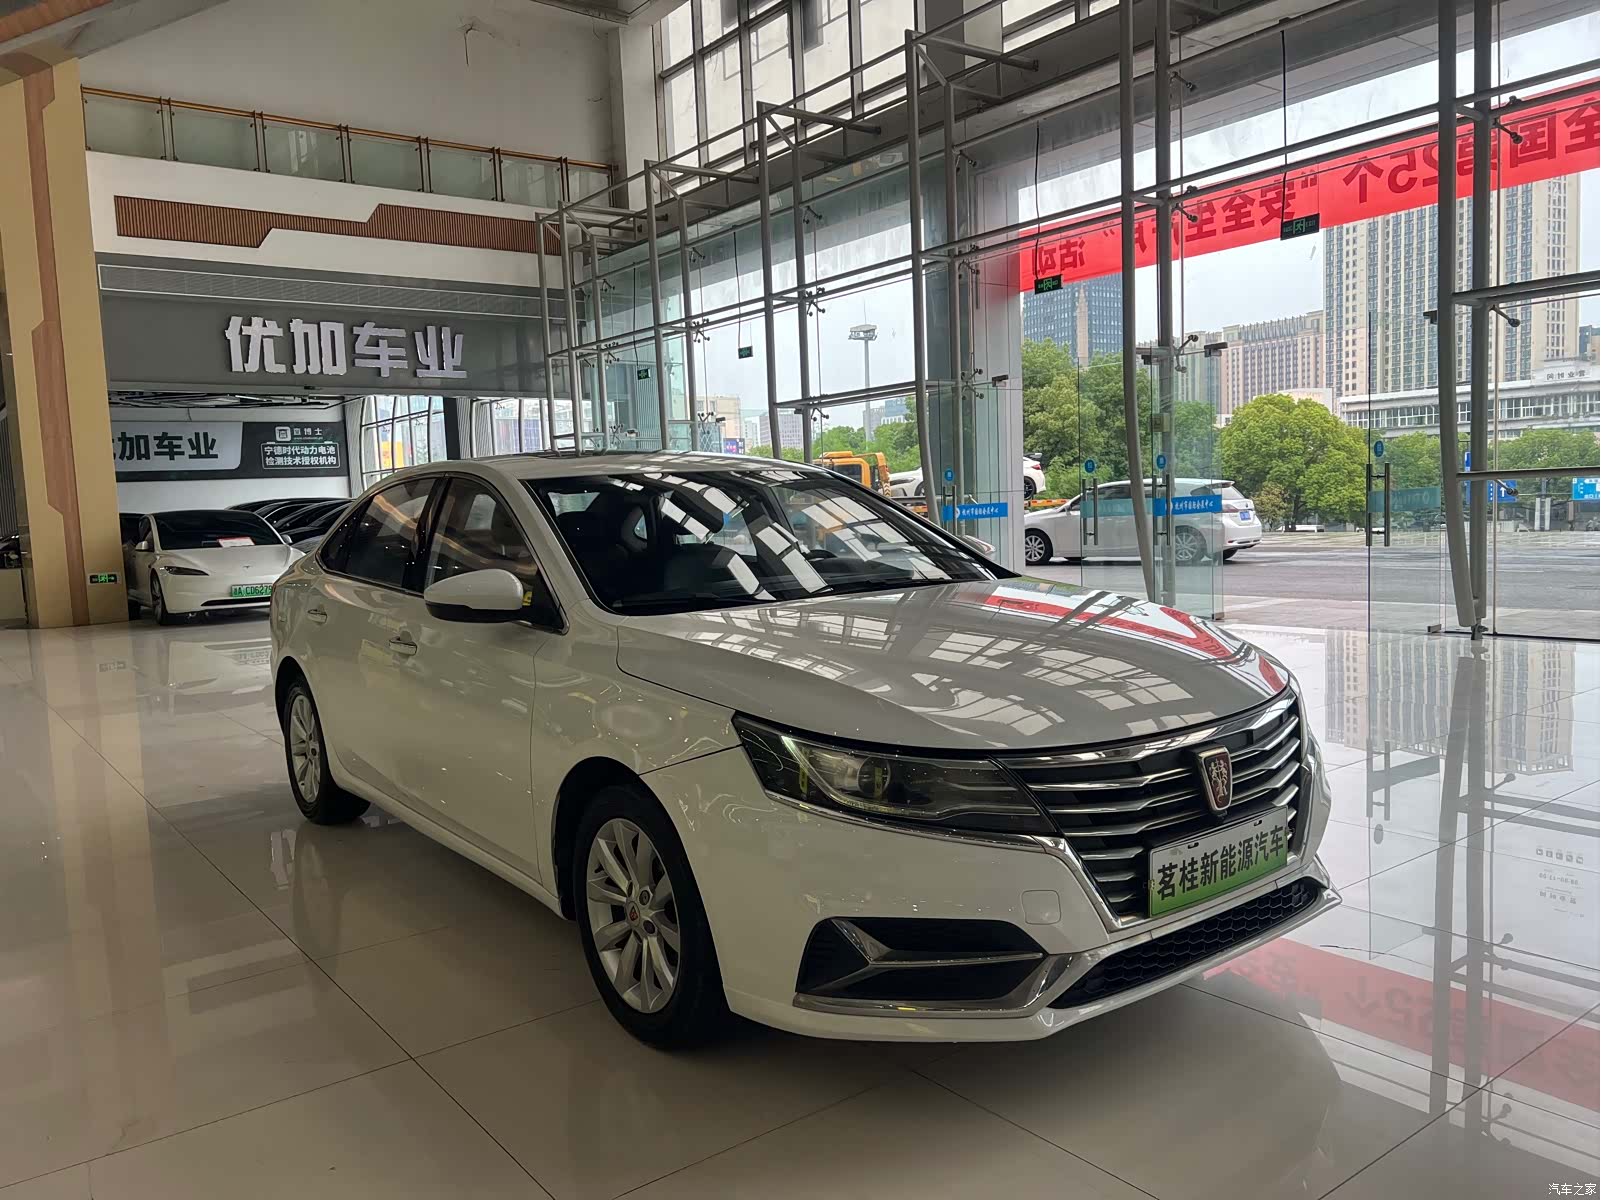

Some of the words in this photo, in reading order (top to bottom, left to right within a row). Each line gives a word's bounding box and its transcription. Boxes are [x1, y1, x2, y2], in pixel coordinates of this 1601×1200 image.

[225, 316, 467, 378] 优加车业
[112, 431, 219, 461] 加车业
[264, 445, 336, 456] 宁德时代动力电池
[265, 456, 337, 466] 检测技术授权机构
[1157, 825, 1284, 900] 茗桂新能源汽车
